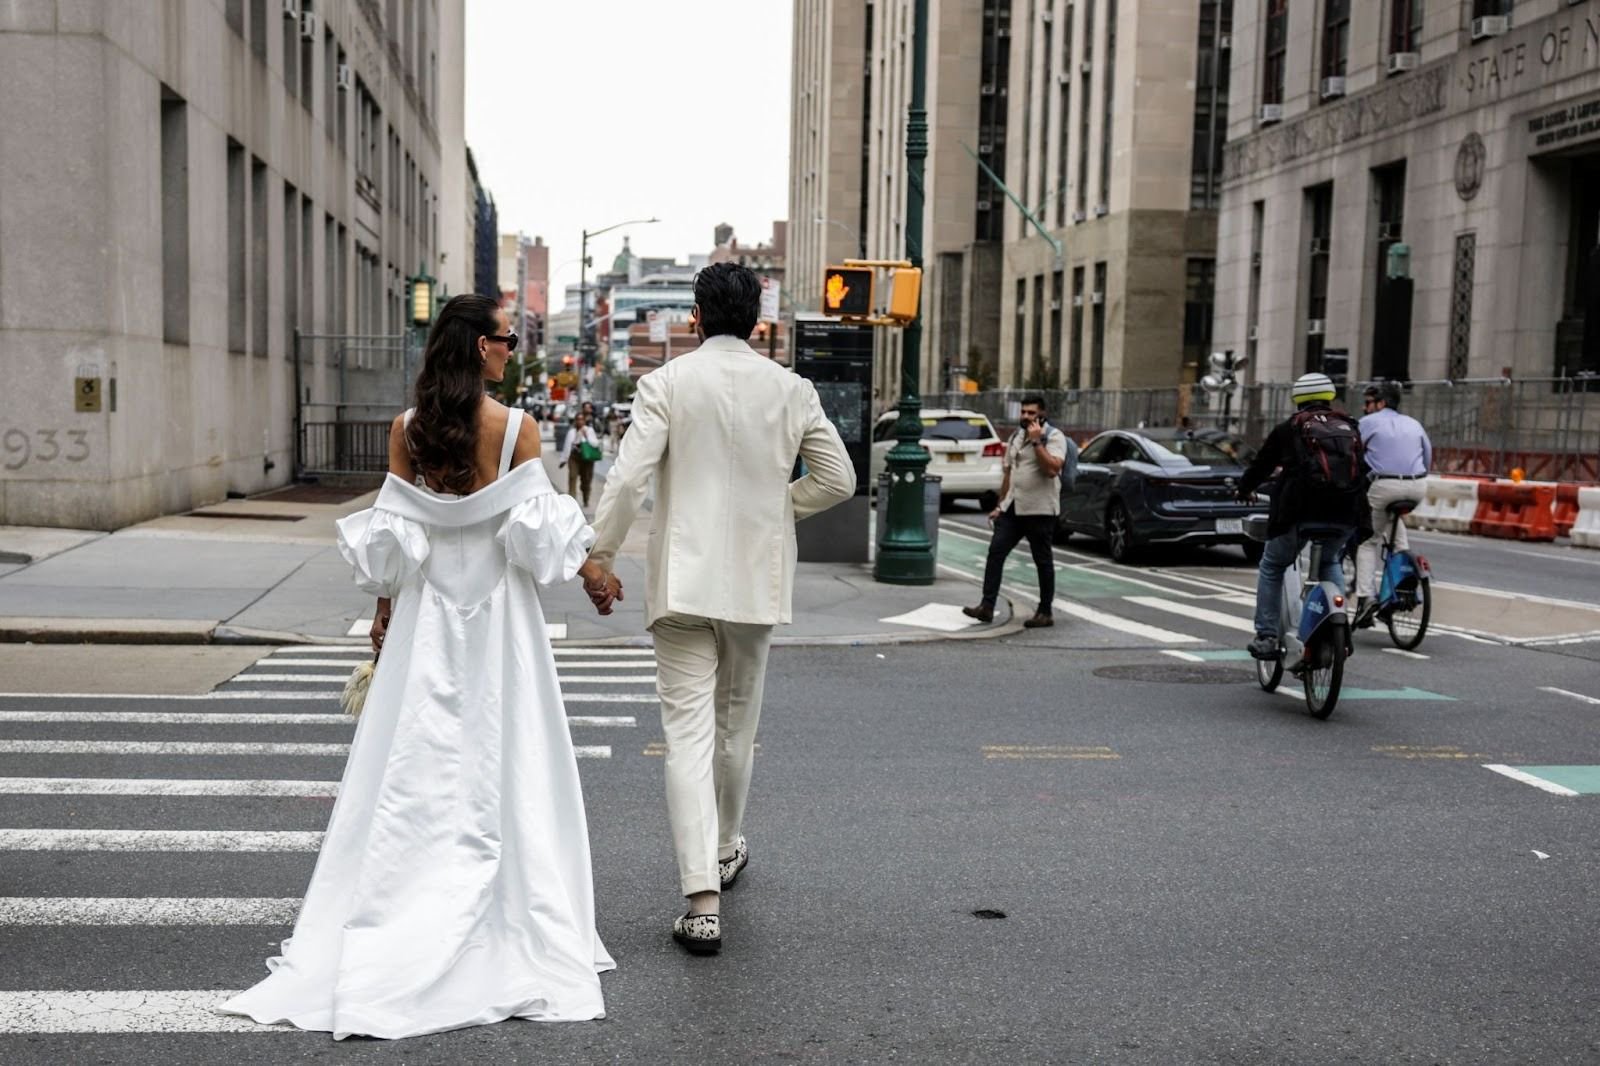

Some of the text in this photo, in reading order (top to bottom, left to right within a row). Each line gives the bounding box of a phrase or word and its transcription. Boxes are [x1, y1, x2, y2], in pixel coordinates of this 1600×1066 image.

[1467, 43, 1526, 92] STATE
[1540, 26, 1571, 65] OF
[3, 428, 90, 470] 933
